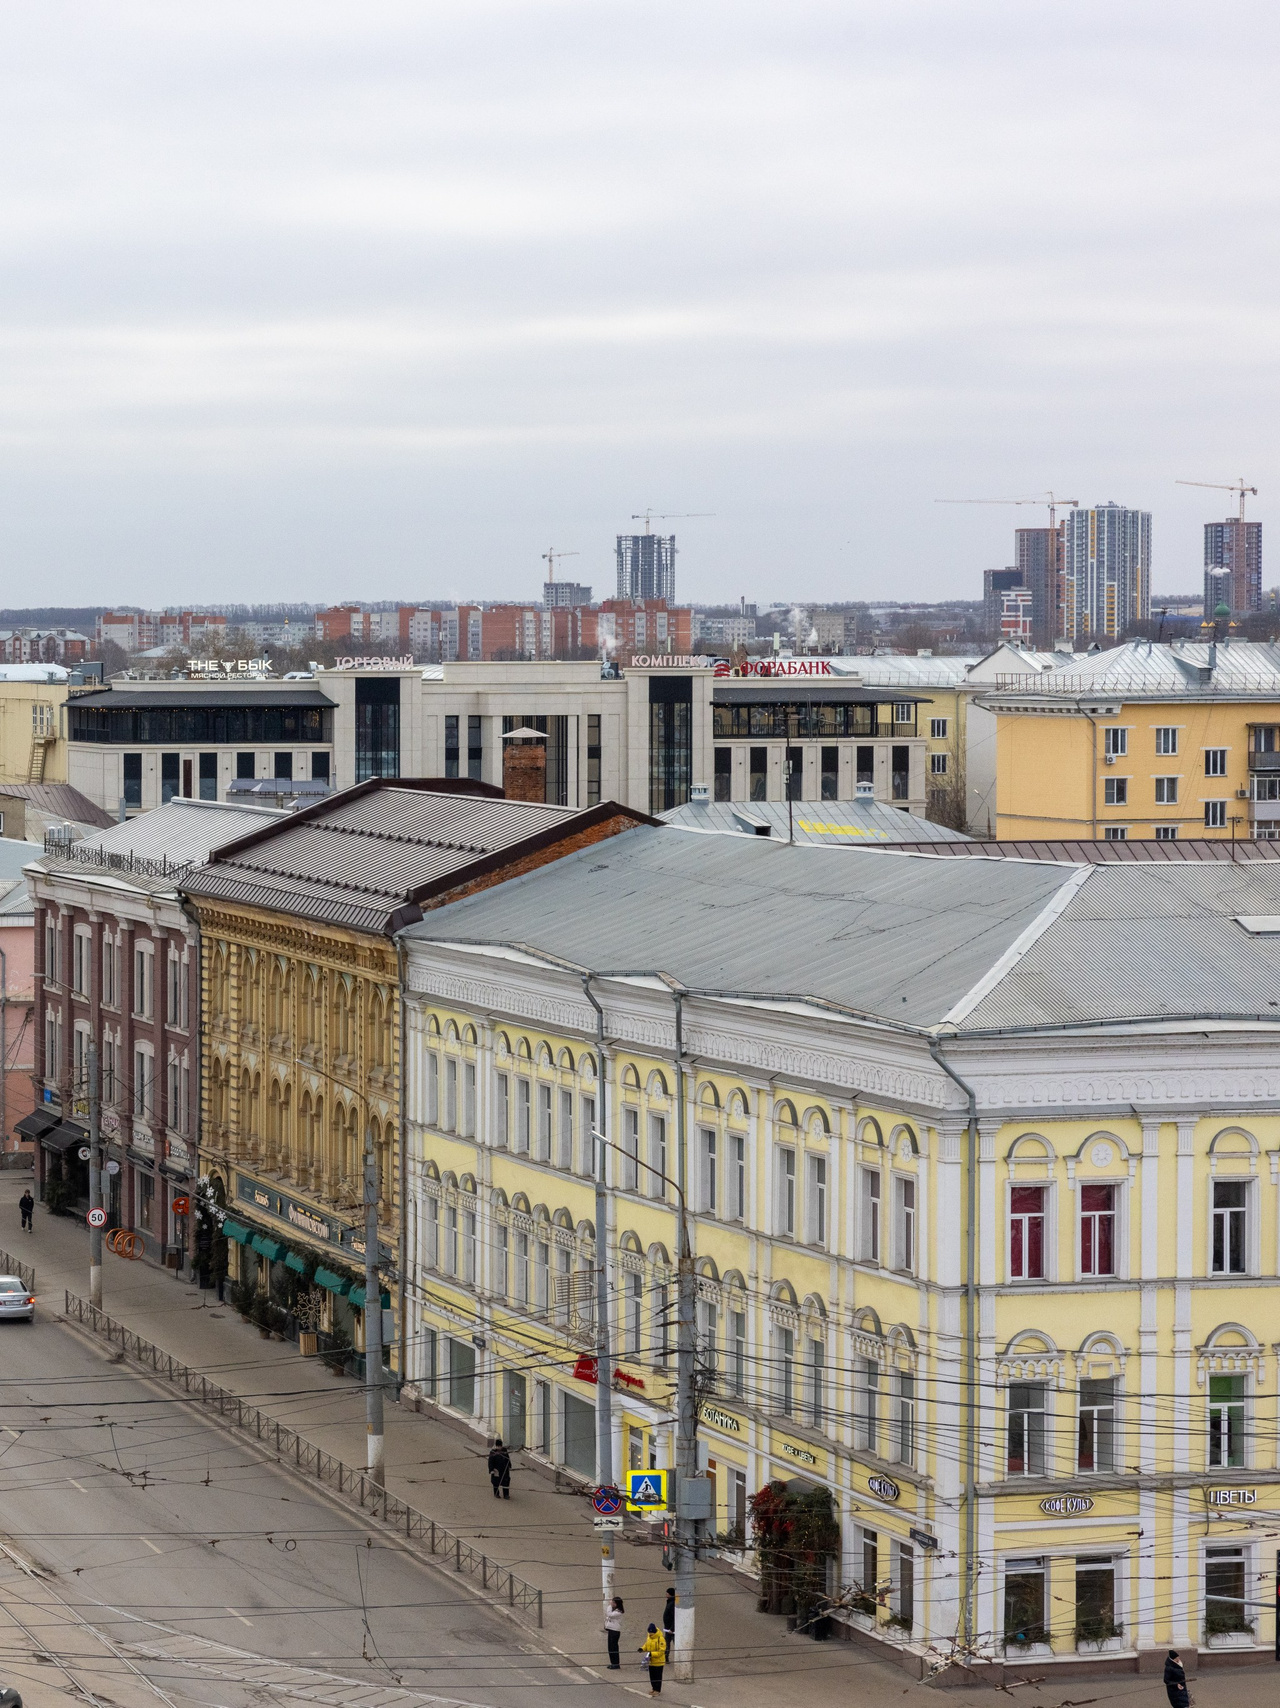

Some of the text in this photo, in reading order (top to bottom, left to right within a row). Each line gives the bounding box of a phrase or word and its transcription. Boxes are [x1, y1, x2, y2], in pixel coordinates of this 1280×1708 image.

[187, 660, 273, 671] THE БЫК
[334, 654, 414, 668] ТОРГОВЫЙ
[631, 655, 708, 667] КОМПЛЕКС
[740, 660, 832, 676] ФОРАБАНК
[191, 671, 226, 679] МЯСНОЙ
[91, 1213, 103, 1222] 50
[703, 1407, 738, 1431] БОТАНИКА
[1209, 1489, 1257, 1506] ЦВЕТЫ
[1045, 1497, 1090, 1513] КОФЕ КУЛЬТ
